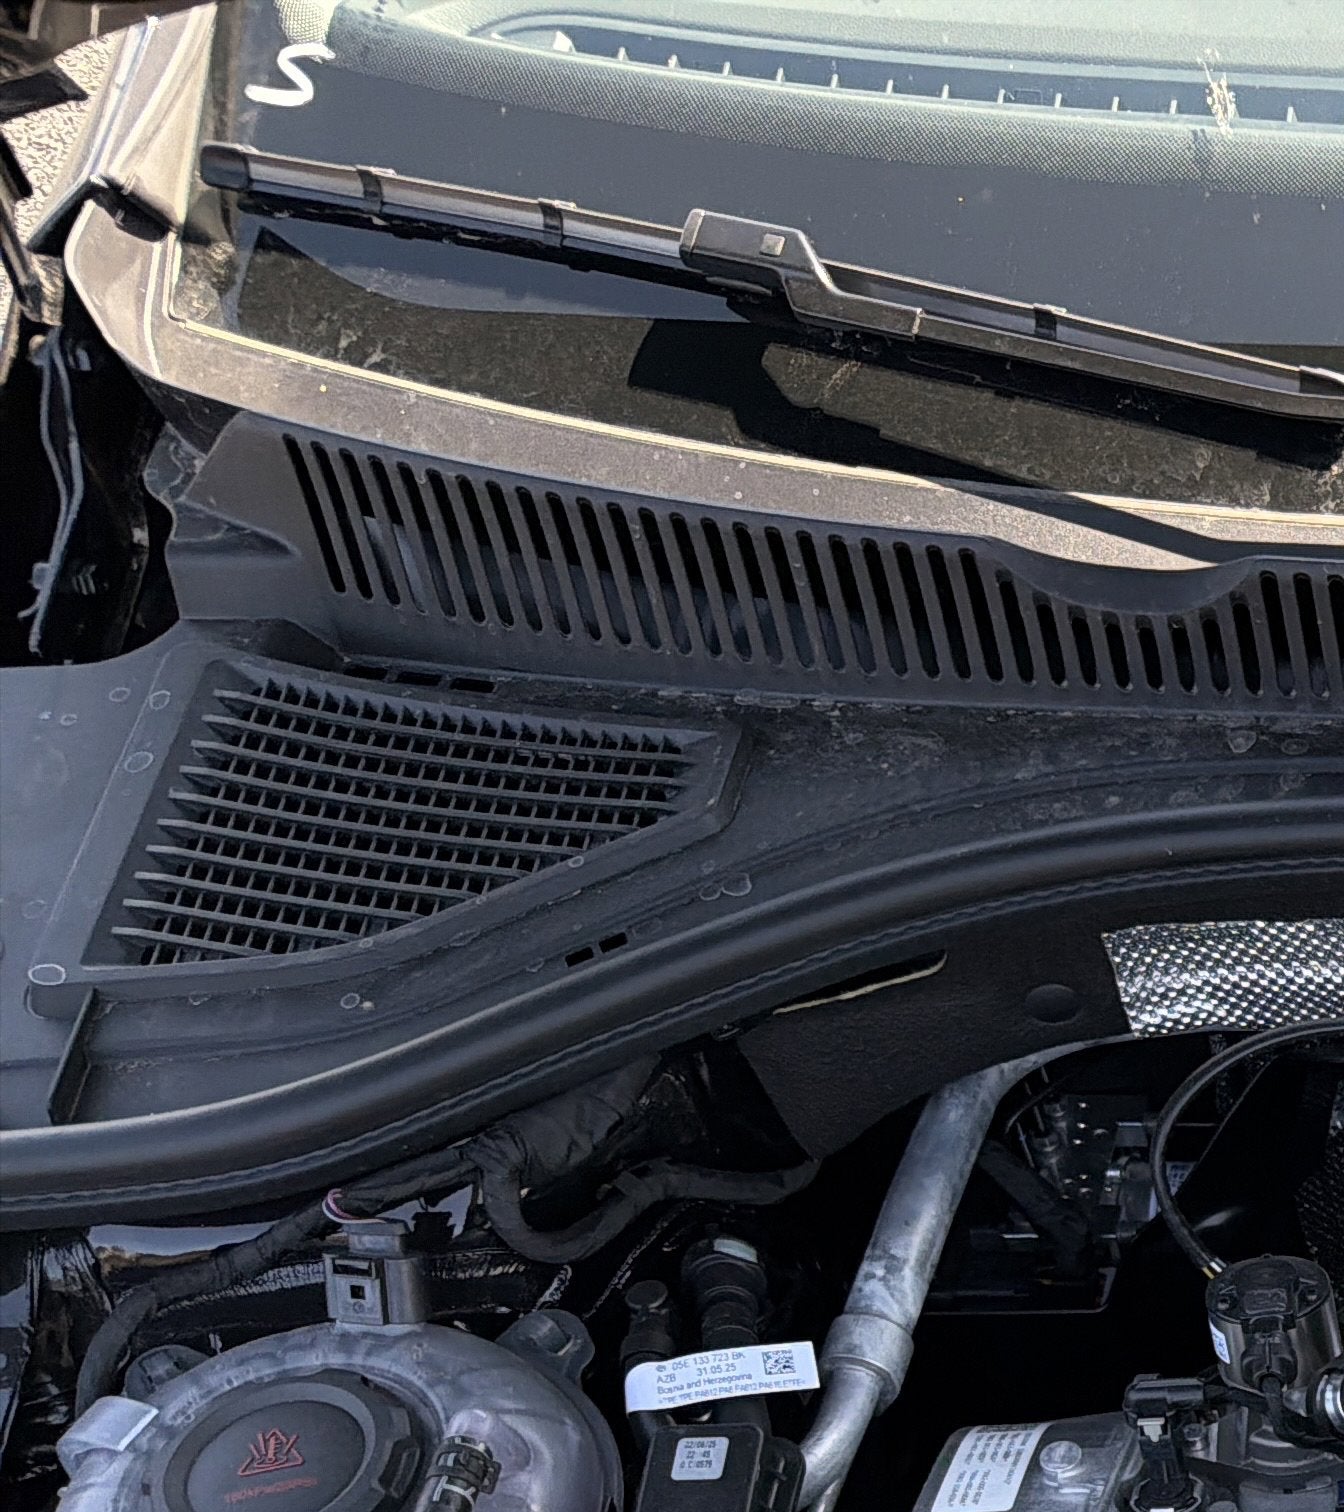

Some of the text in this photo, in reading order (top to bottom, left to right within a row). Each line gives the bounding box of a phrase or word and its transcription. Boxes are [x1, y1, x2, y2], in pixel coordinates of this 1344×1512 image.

[693, 1357, 710, 1366] 133
[712, 1354, 730, 1363] 723
[657, 1372, 753, 1395] Bosnia and Herzegovina
